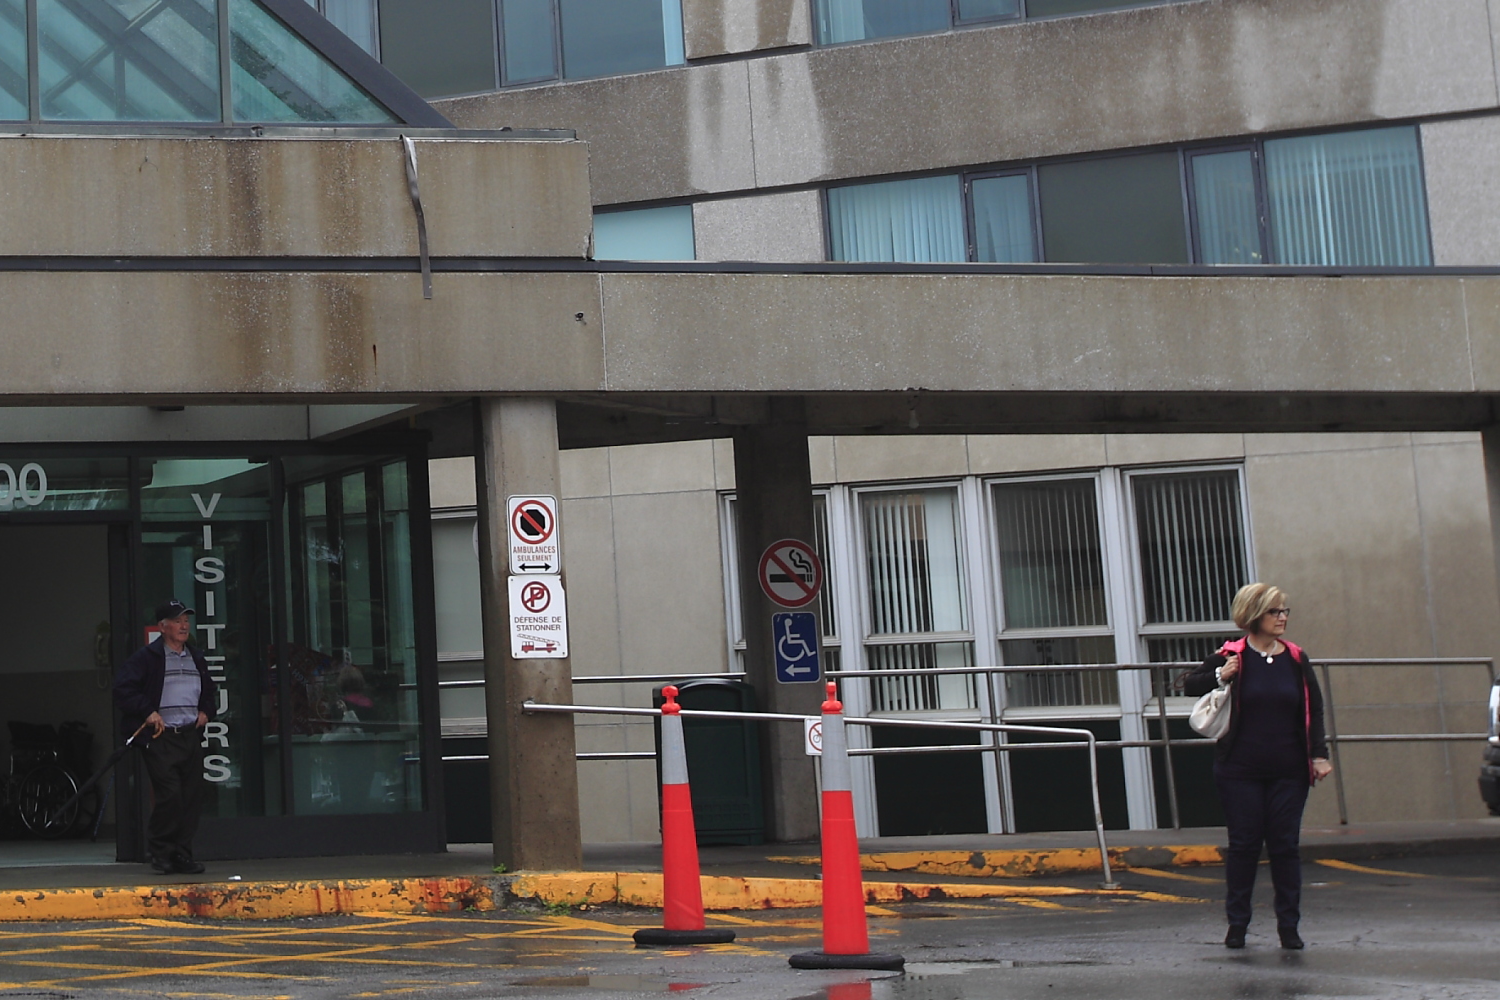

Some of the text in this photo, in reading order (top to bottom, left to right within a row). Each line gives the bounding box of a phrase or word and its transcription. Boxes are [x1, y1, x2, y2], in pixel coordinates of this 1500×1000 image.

[513, 545, 556, 554] AMBULANCES
[517, 554, 552, 562] SEULEMENT
[514, 615, 562, 624] DÉFENSE DE
[516, 624, 562, 632] STATIONNER
